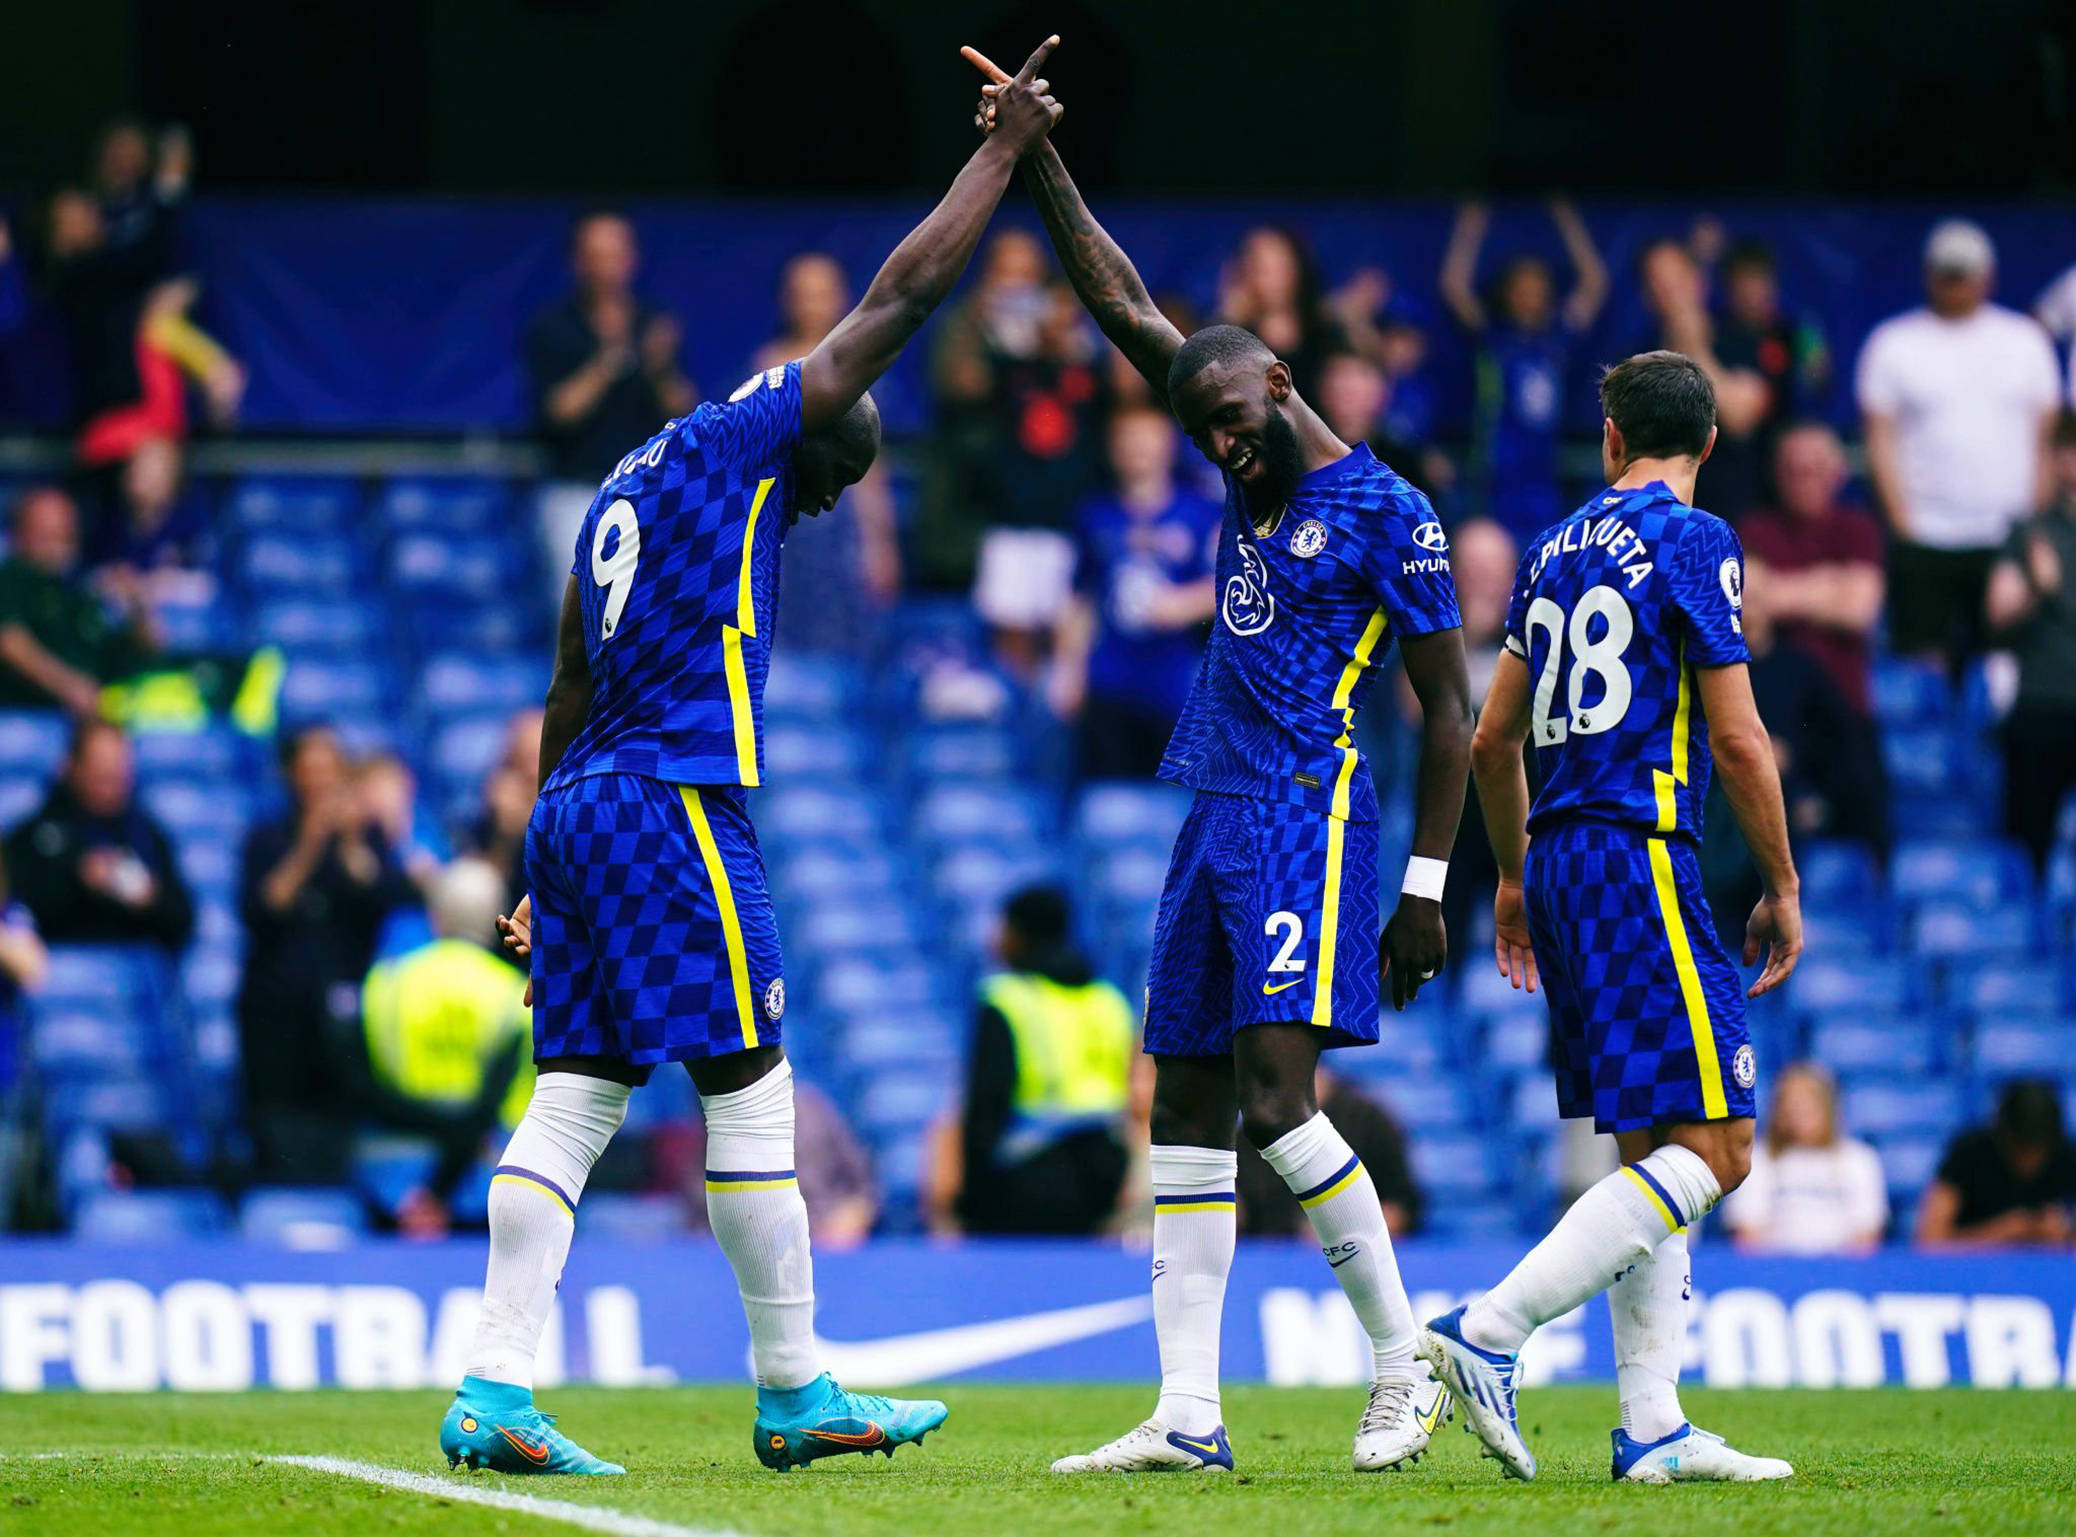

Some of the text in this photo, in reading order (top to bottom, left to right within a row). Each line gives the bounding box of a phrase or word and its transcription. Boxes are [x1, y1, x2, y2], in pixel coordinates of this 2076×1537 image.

[592, 499, 640, 641] 9
[1525, 585, 1634, 748] 28
[1264, 911, 1306, 972] 2
[1322, 1241, 1357, 1257] CFC
